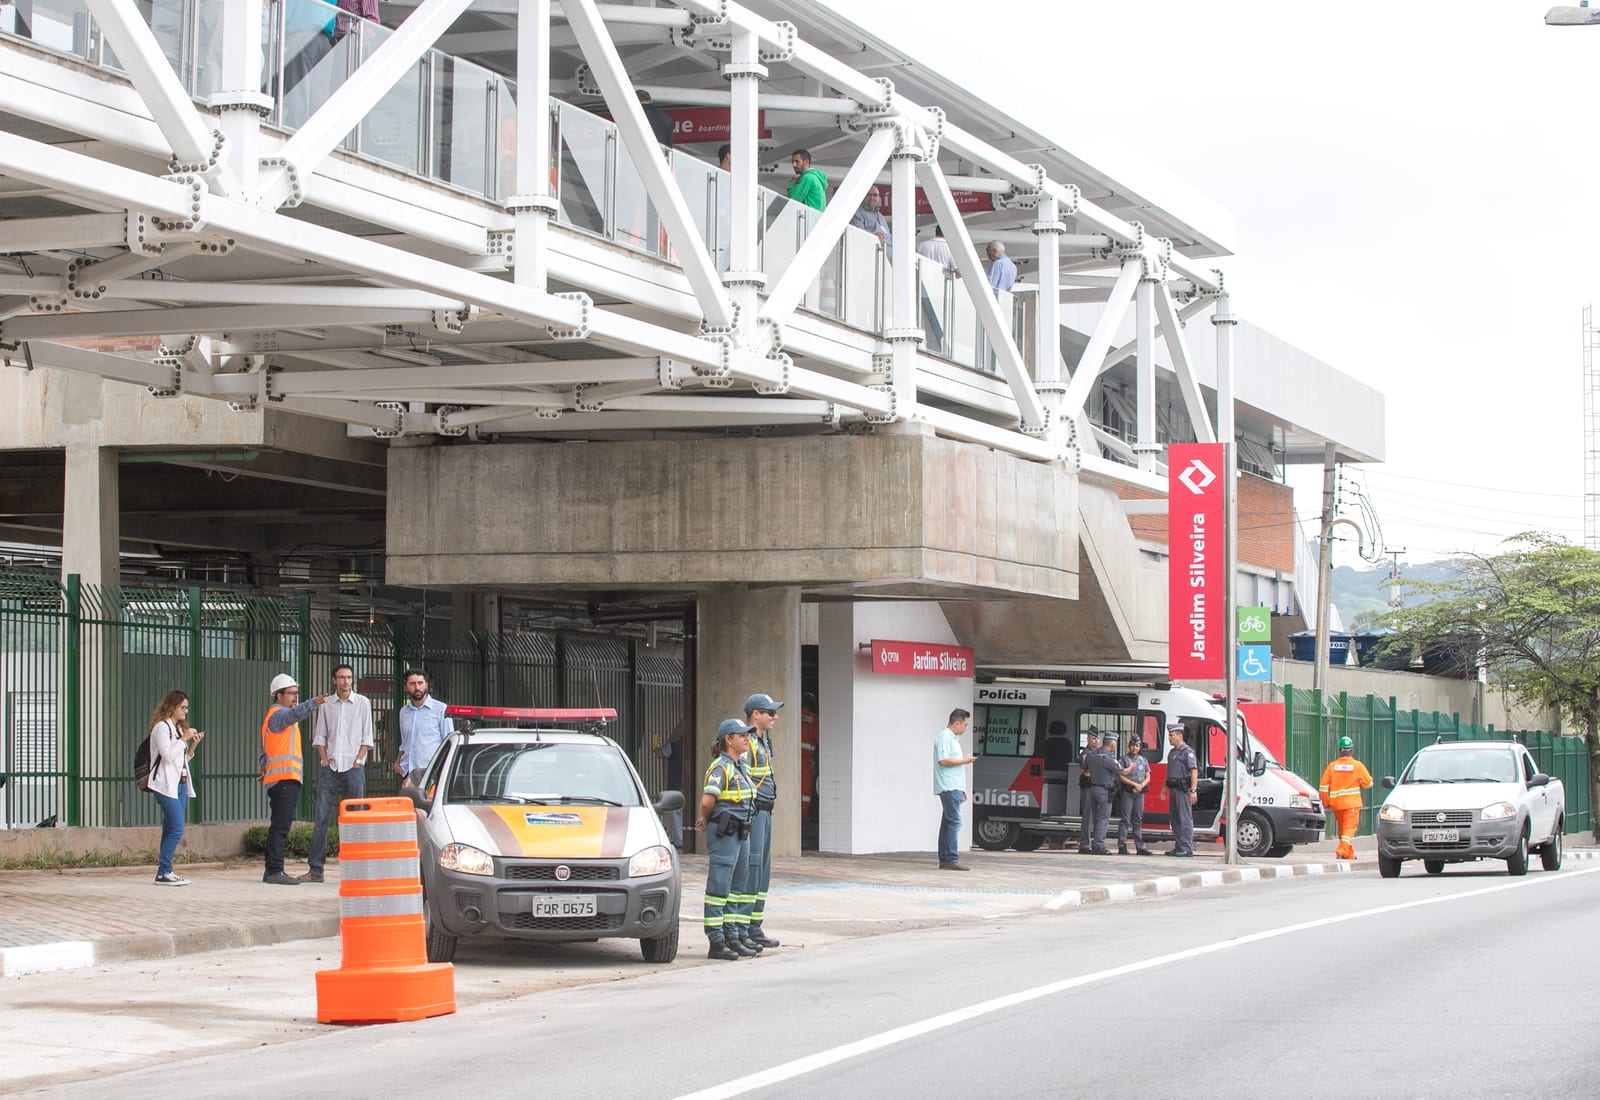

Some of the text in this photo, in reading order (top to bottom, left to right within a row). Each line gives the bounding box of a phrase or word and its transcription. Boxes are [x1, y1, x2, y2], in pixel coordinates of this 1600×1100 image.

[1189, 513, 1206, 661] Jardim Silveira
[912, 650, 939, 670] Jardim
[939, 652, 967, 671] Silveira
[979, 689, 1027, 700] Polícia
[973, 788, 1030, 807] olícia
[563, 903, 594, 914] 0675
